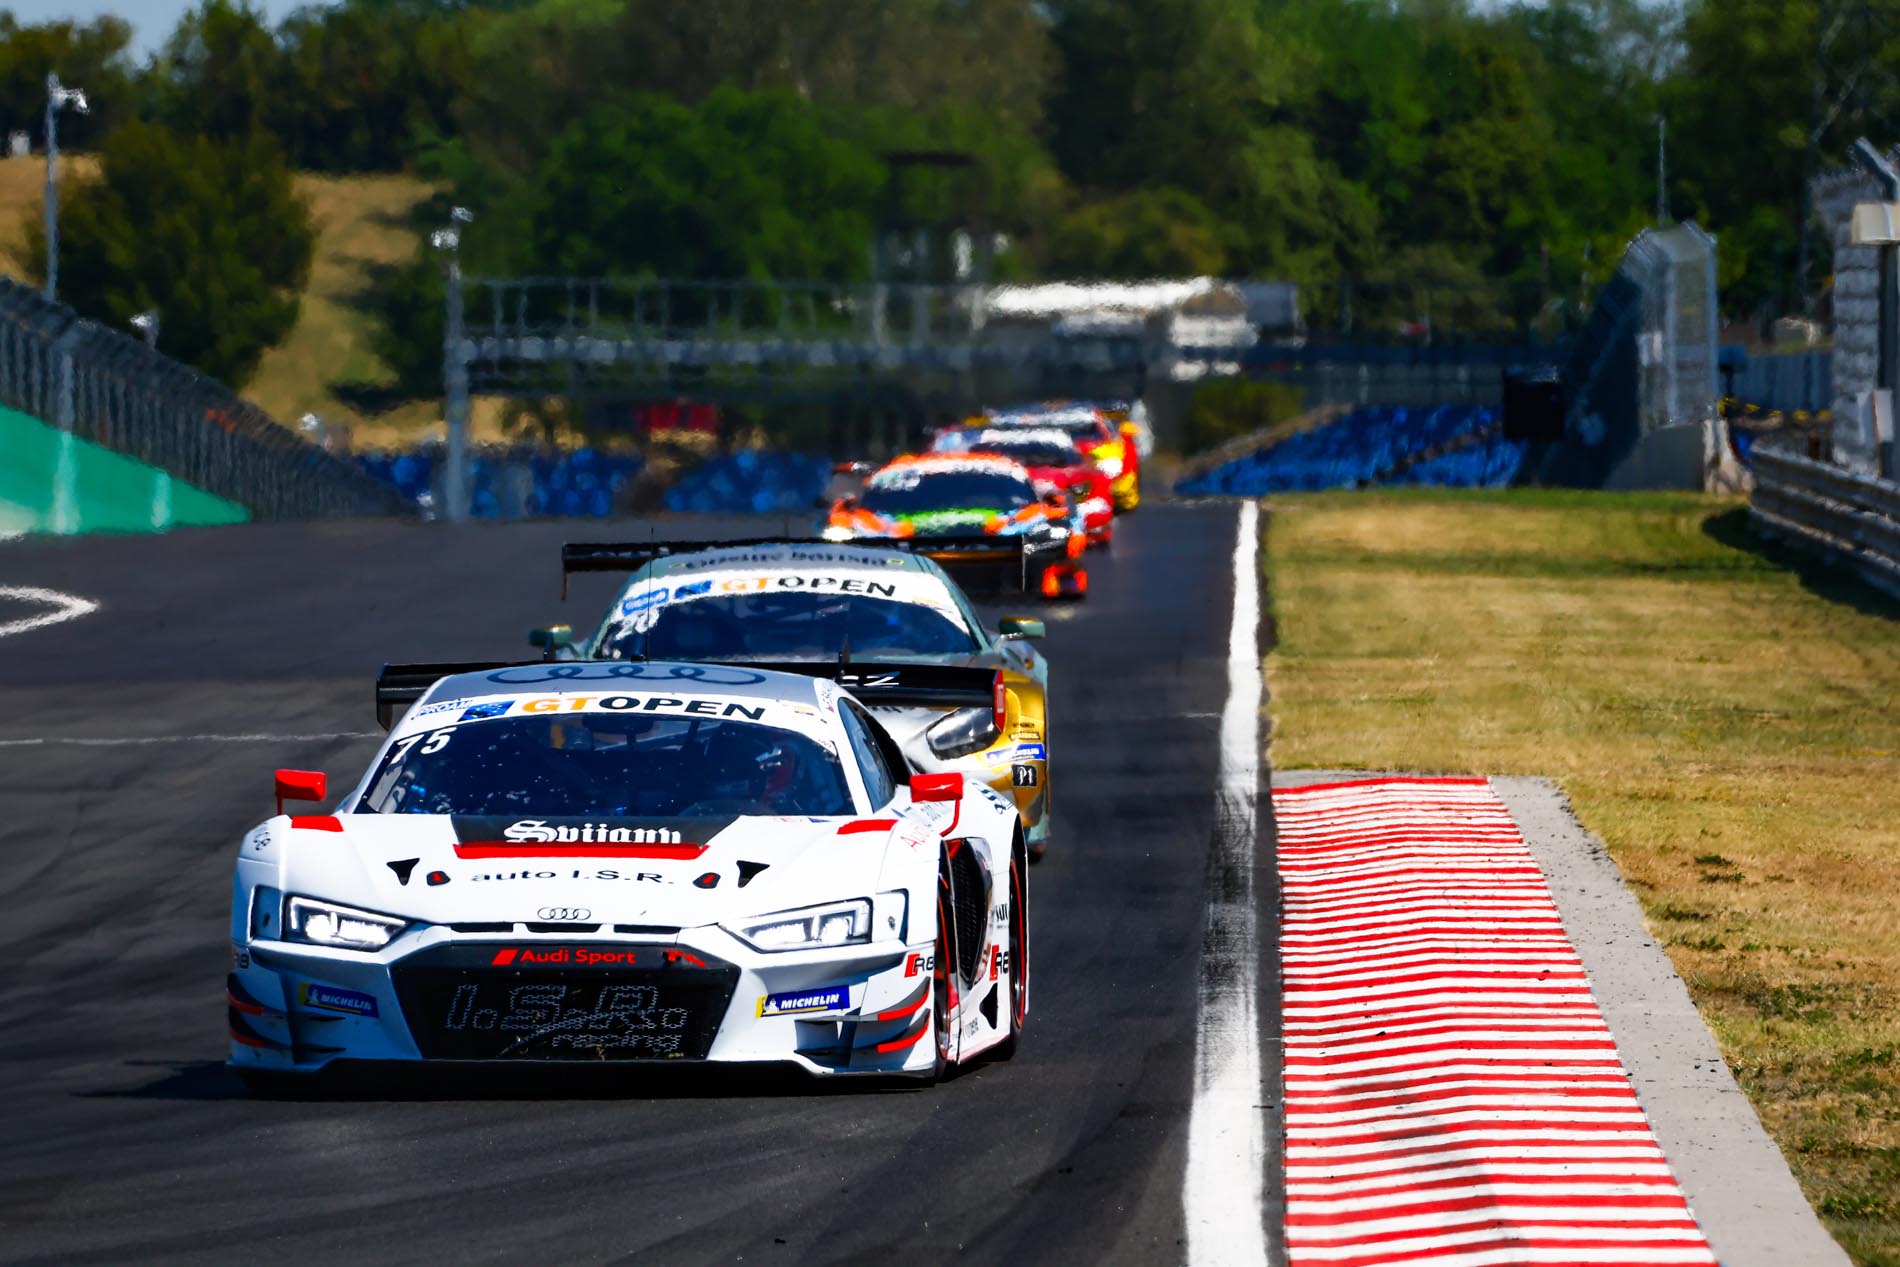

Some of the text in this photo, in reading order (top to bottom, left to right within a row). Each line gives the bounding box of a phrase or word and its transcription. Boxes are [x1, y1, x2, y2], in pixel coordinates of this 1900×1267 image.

[390, 727, 457, 765] 75
[471, 870, 675, 884] auto I.S.R.
[520, 949, 637, 965] Audi Sport
[912, 956, 934, 973] R8
[321, 994, 372, 1010] MICHELIN
[780, 993, 840, 1009] MICHELIN
